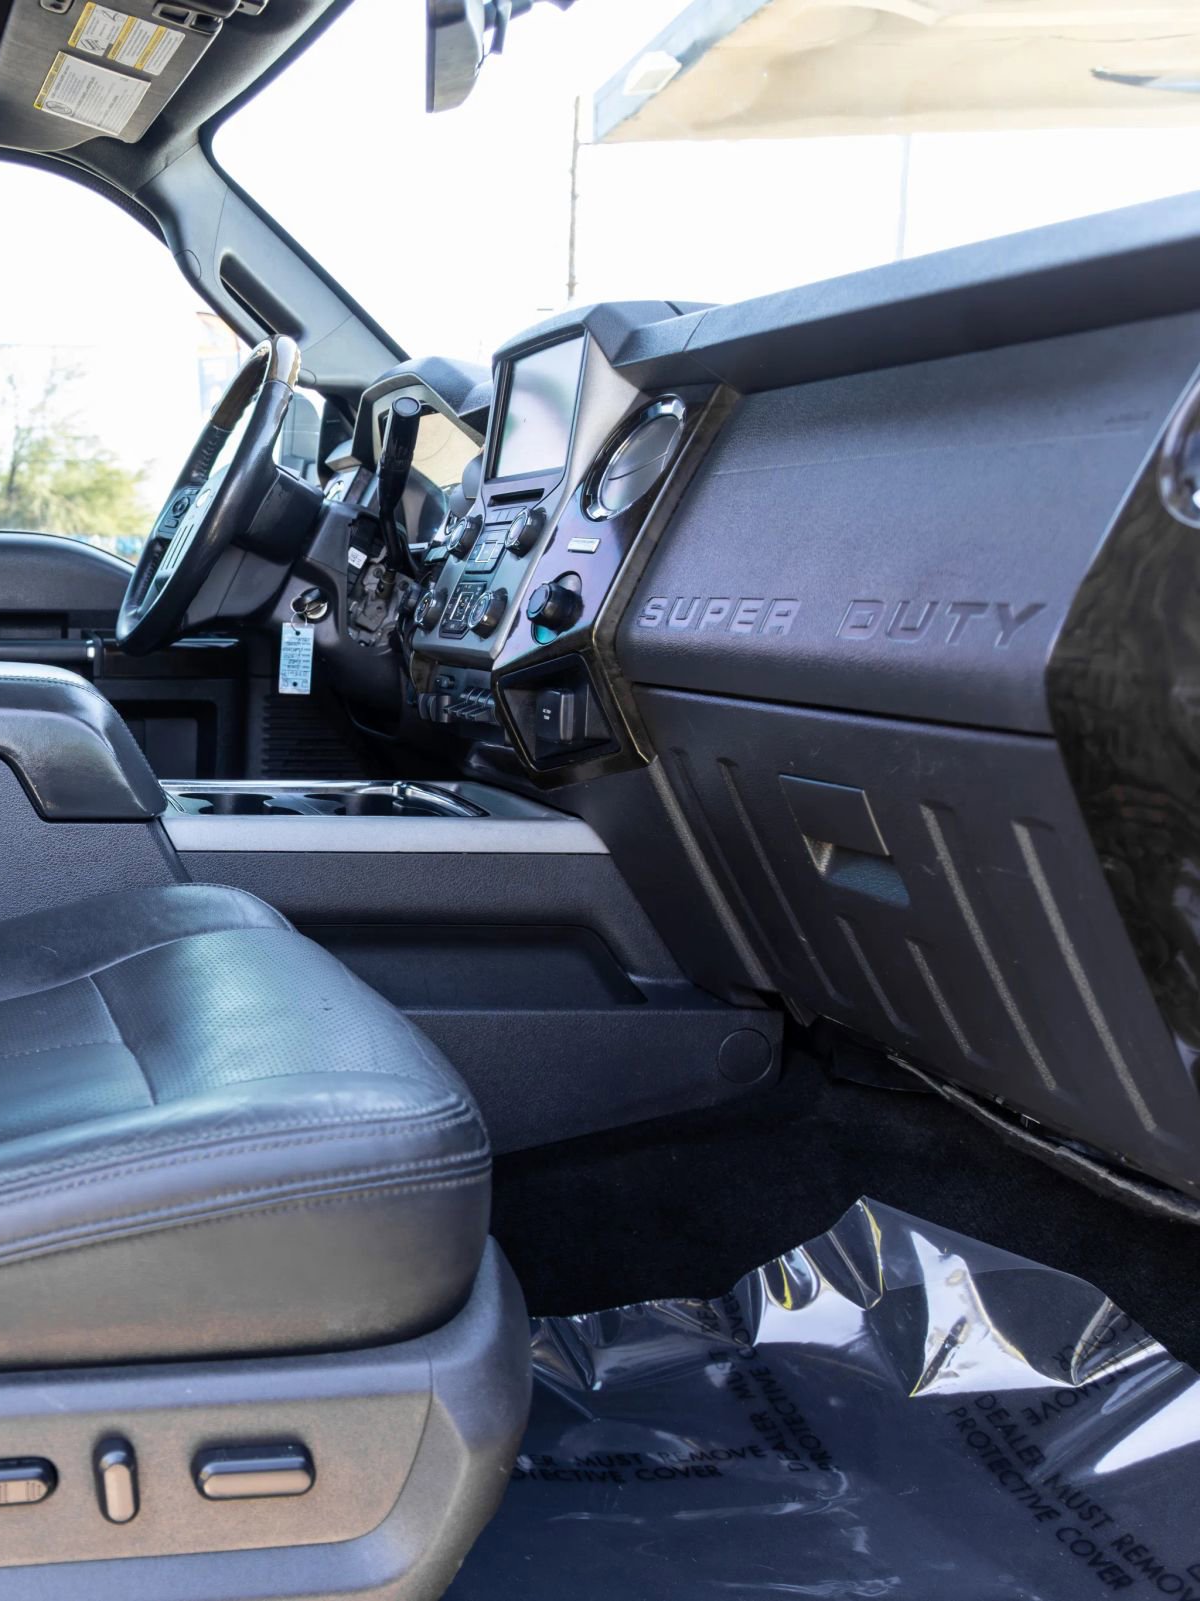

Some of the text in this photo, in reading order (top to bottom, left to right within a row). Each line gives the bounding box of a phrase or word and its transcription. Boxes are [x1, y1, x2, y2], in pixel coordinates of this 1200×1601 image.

[637, 596, 1047, 649] SUPER DUTY
[575, 1452, 643, 1468] MUST
[635, 1464, 722, 1481] COVER
[974, 1393, 1046, 1469] DEALER
[1043, 1472, 1115, 1530] MUST
[948, 1406, 1134, 1591] PROTECTIVE COVER
